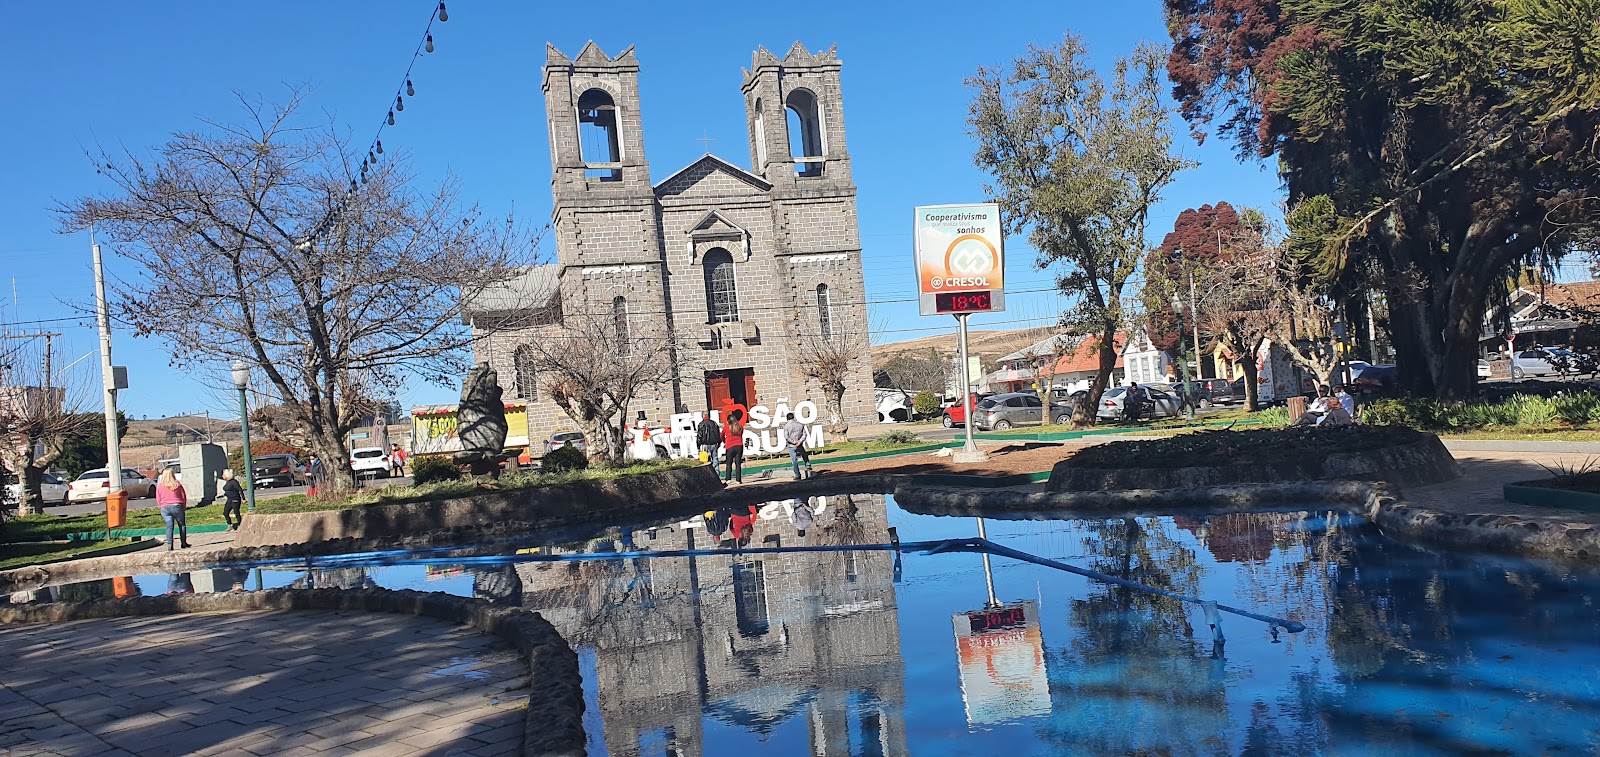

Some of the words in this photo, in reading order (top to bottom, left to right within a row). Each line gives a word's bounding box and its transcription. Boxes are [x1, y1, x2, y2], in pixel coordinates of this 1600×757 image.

[925, 213, 987, 222] Cooperativismo
[956, 226, 986, 234] sonhos
[945, 276, 990, 287] CRESOL
[749, 397, 818, 429] SÃO
